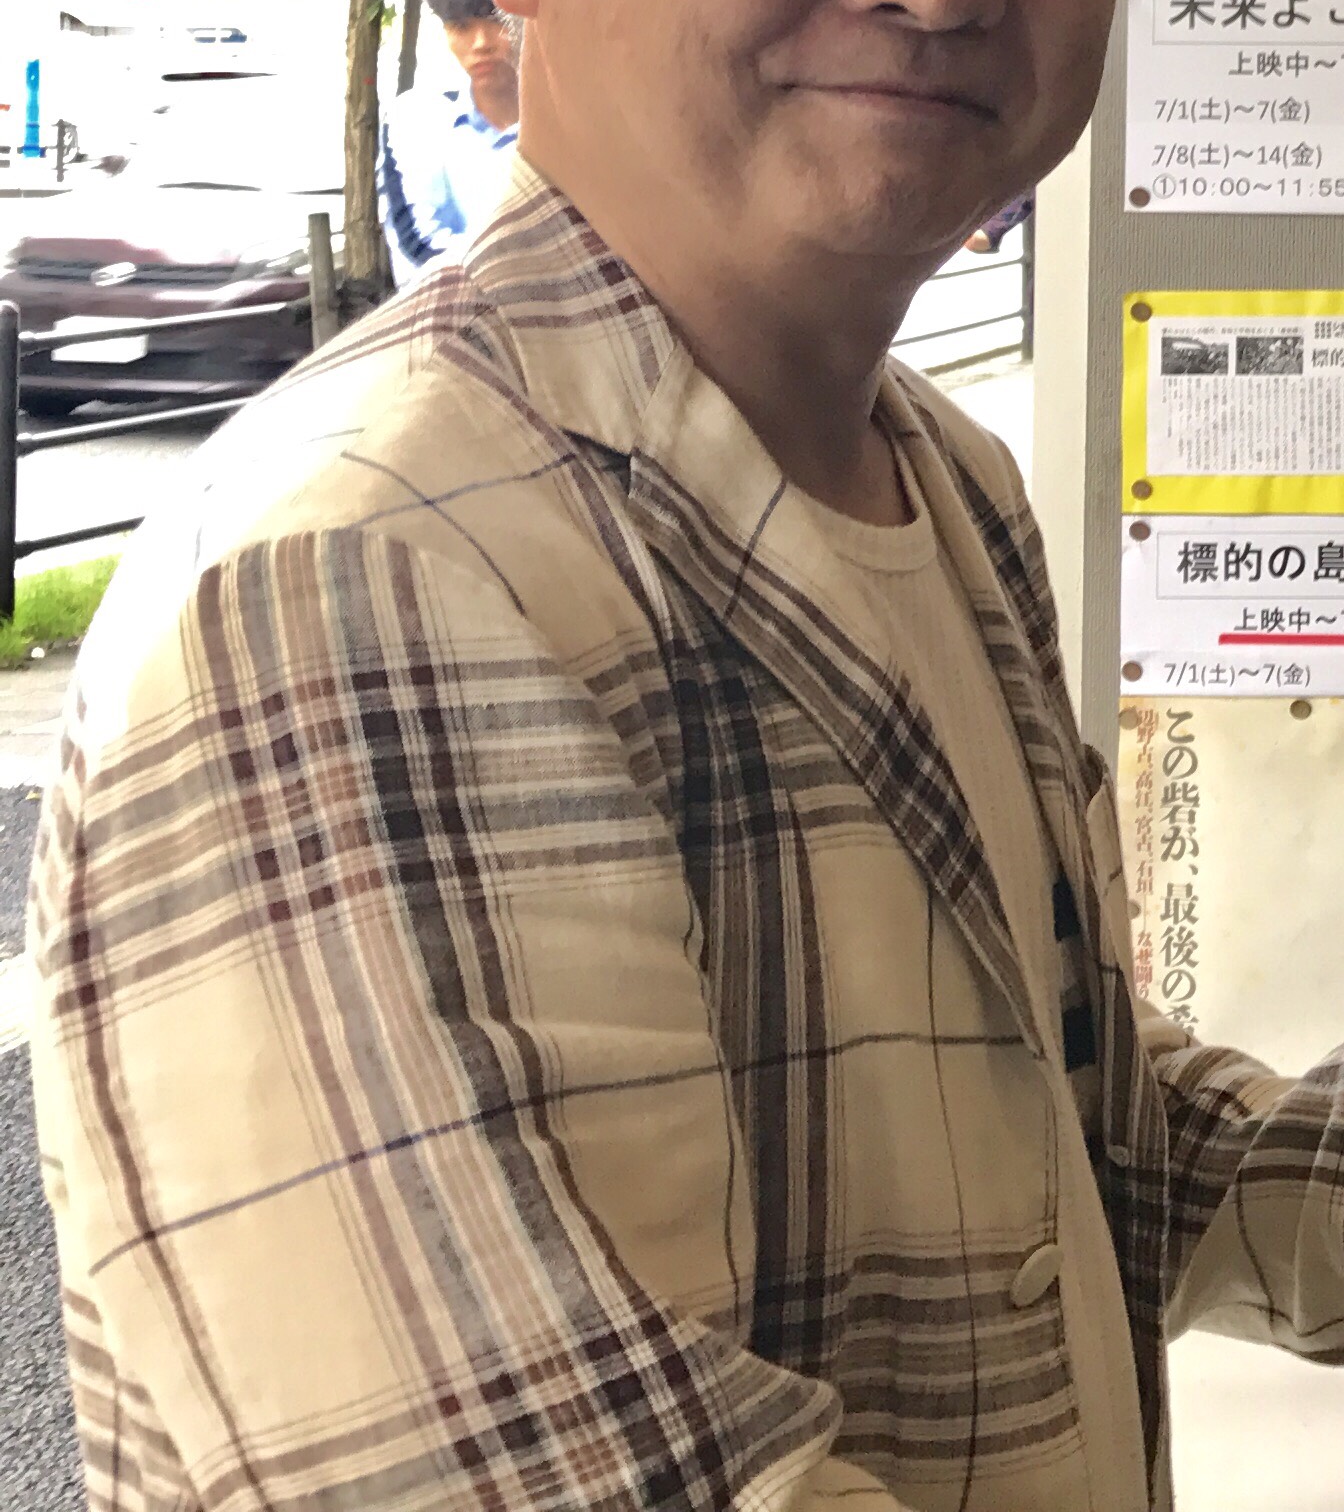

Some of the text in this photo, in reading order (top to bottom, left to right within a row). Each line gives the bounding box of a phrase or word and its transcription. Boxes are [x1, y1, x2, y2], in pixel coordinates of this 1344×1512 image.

[1153, 97, 1311, 124] 7/1(土)～7(金)
[1151, 141, 1323, 170] 7/8(土)～14(金)
[1164, 662, 1311, 687] 7/1(土)～7(金)
